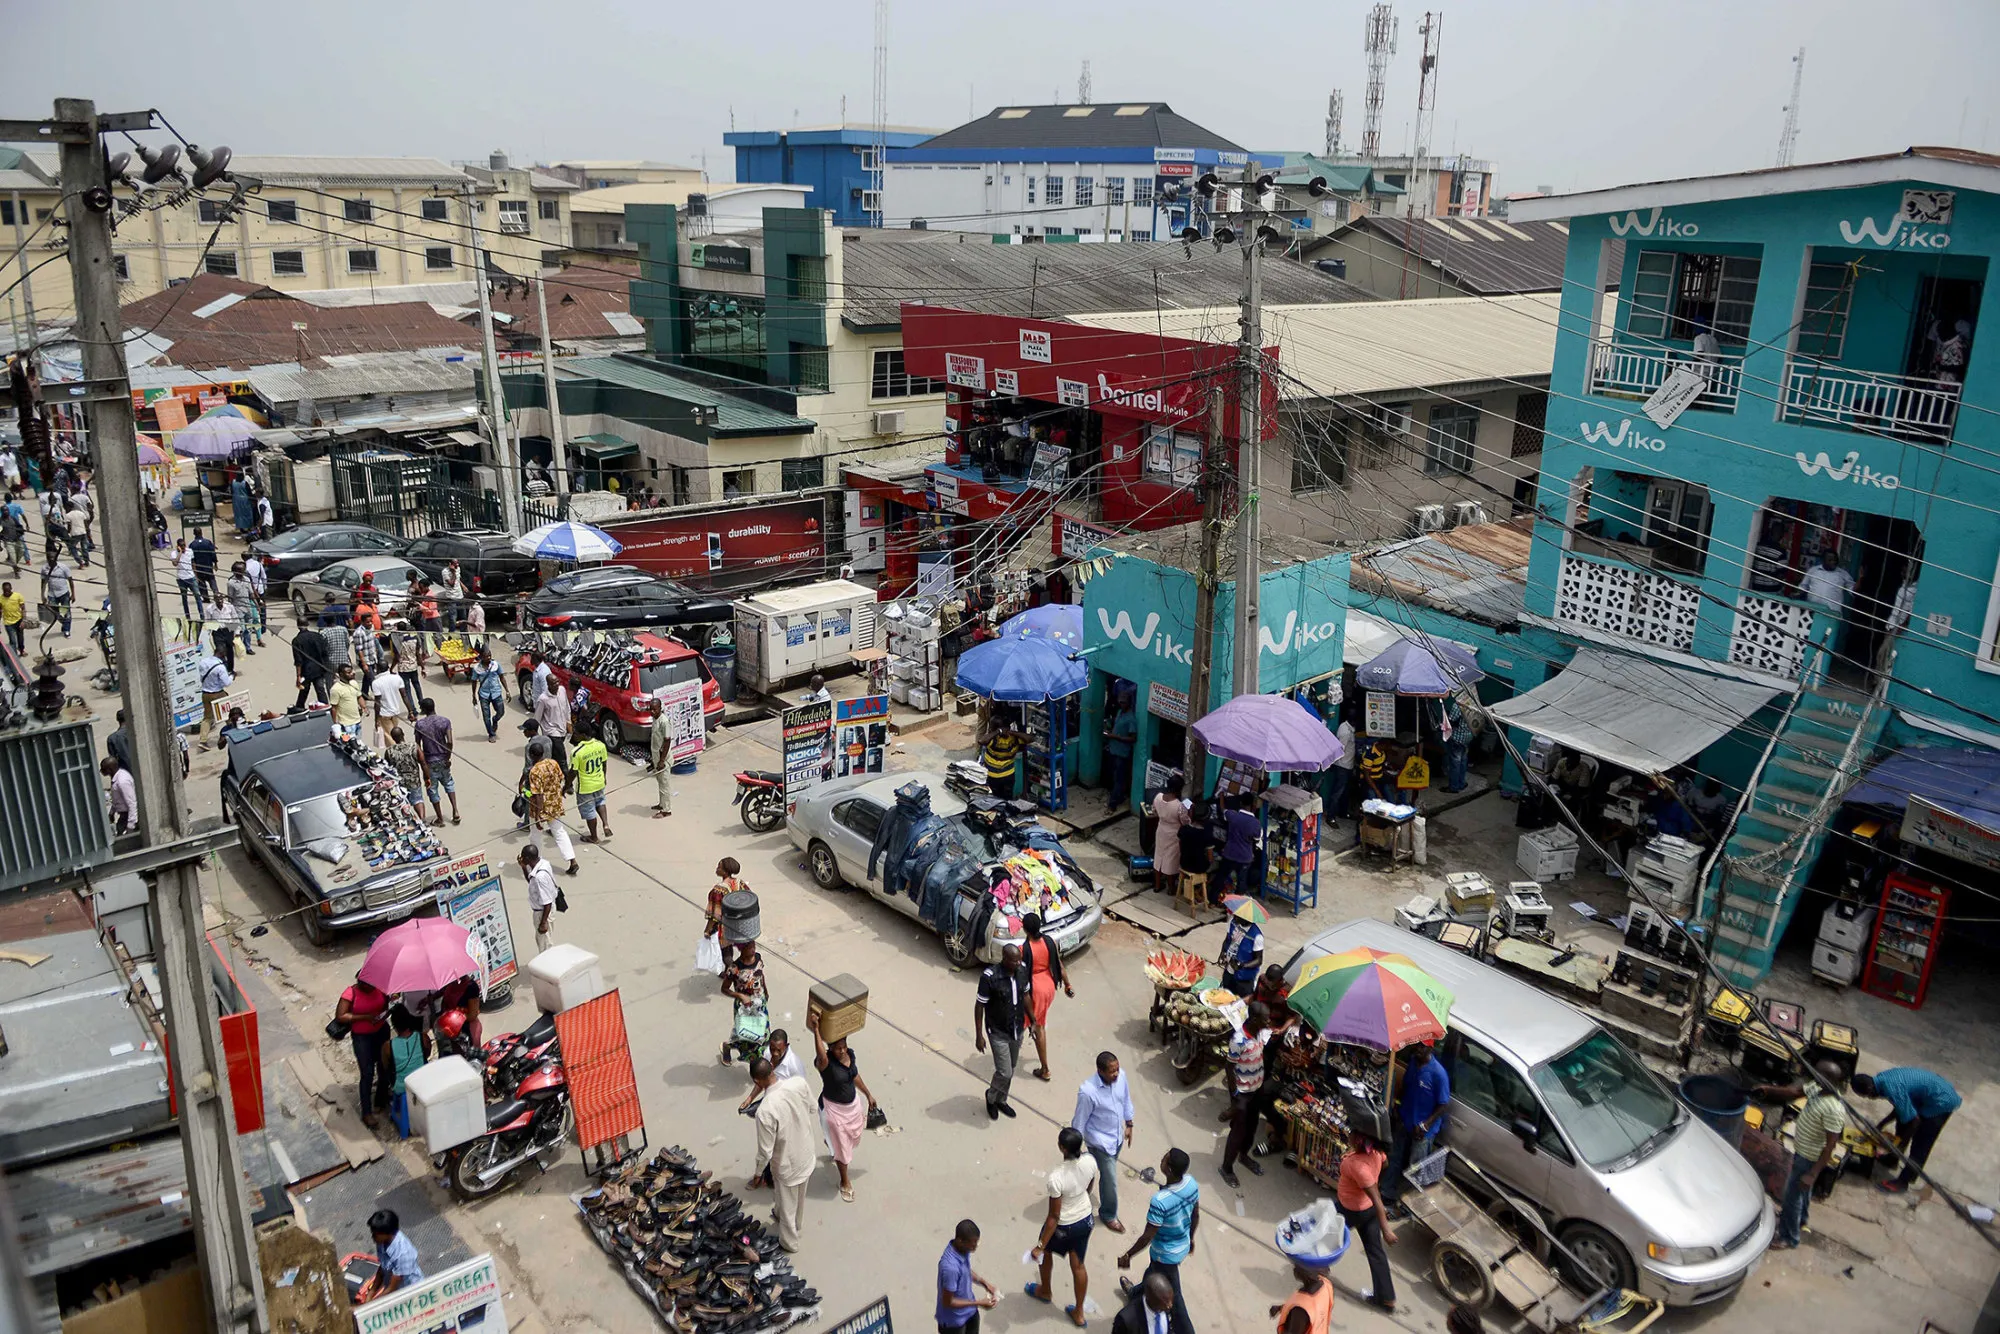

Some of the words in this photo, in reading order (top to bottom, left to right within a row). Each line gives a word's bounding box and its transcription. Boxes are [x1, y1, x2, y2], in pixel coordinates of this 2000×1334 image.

[1608, 206, 1699, 237] Wiko
[1839, 212, 1951, 249] Wiko
[1579, 419, 1667, 452] Wiko
[1795, 451, 1900, 490] Wiko
[662, 535, 688, 546] strength
[689, 533, 701, 542] and
[728, 524, 772, 539] durability
[810, 547, 820, 556] P7
[1372, 666, 1392, 675] SOLO
[1152, 683, 1186, 700] UPGRADE
[785, 705, 831, 727] Affordable
[816, 720, 828, 729] Link
[787, 747, 822, 763] NOKIA
[787, 766, 822, 783] TECNO
[451, 853, 486, 872] CHIBEST
[442, 1265, 491, 1297] GREAT
